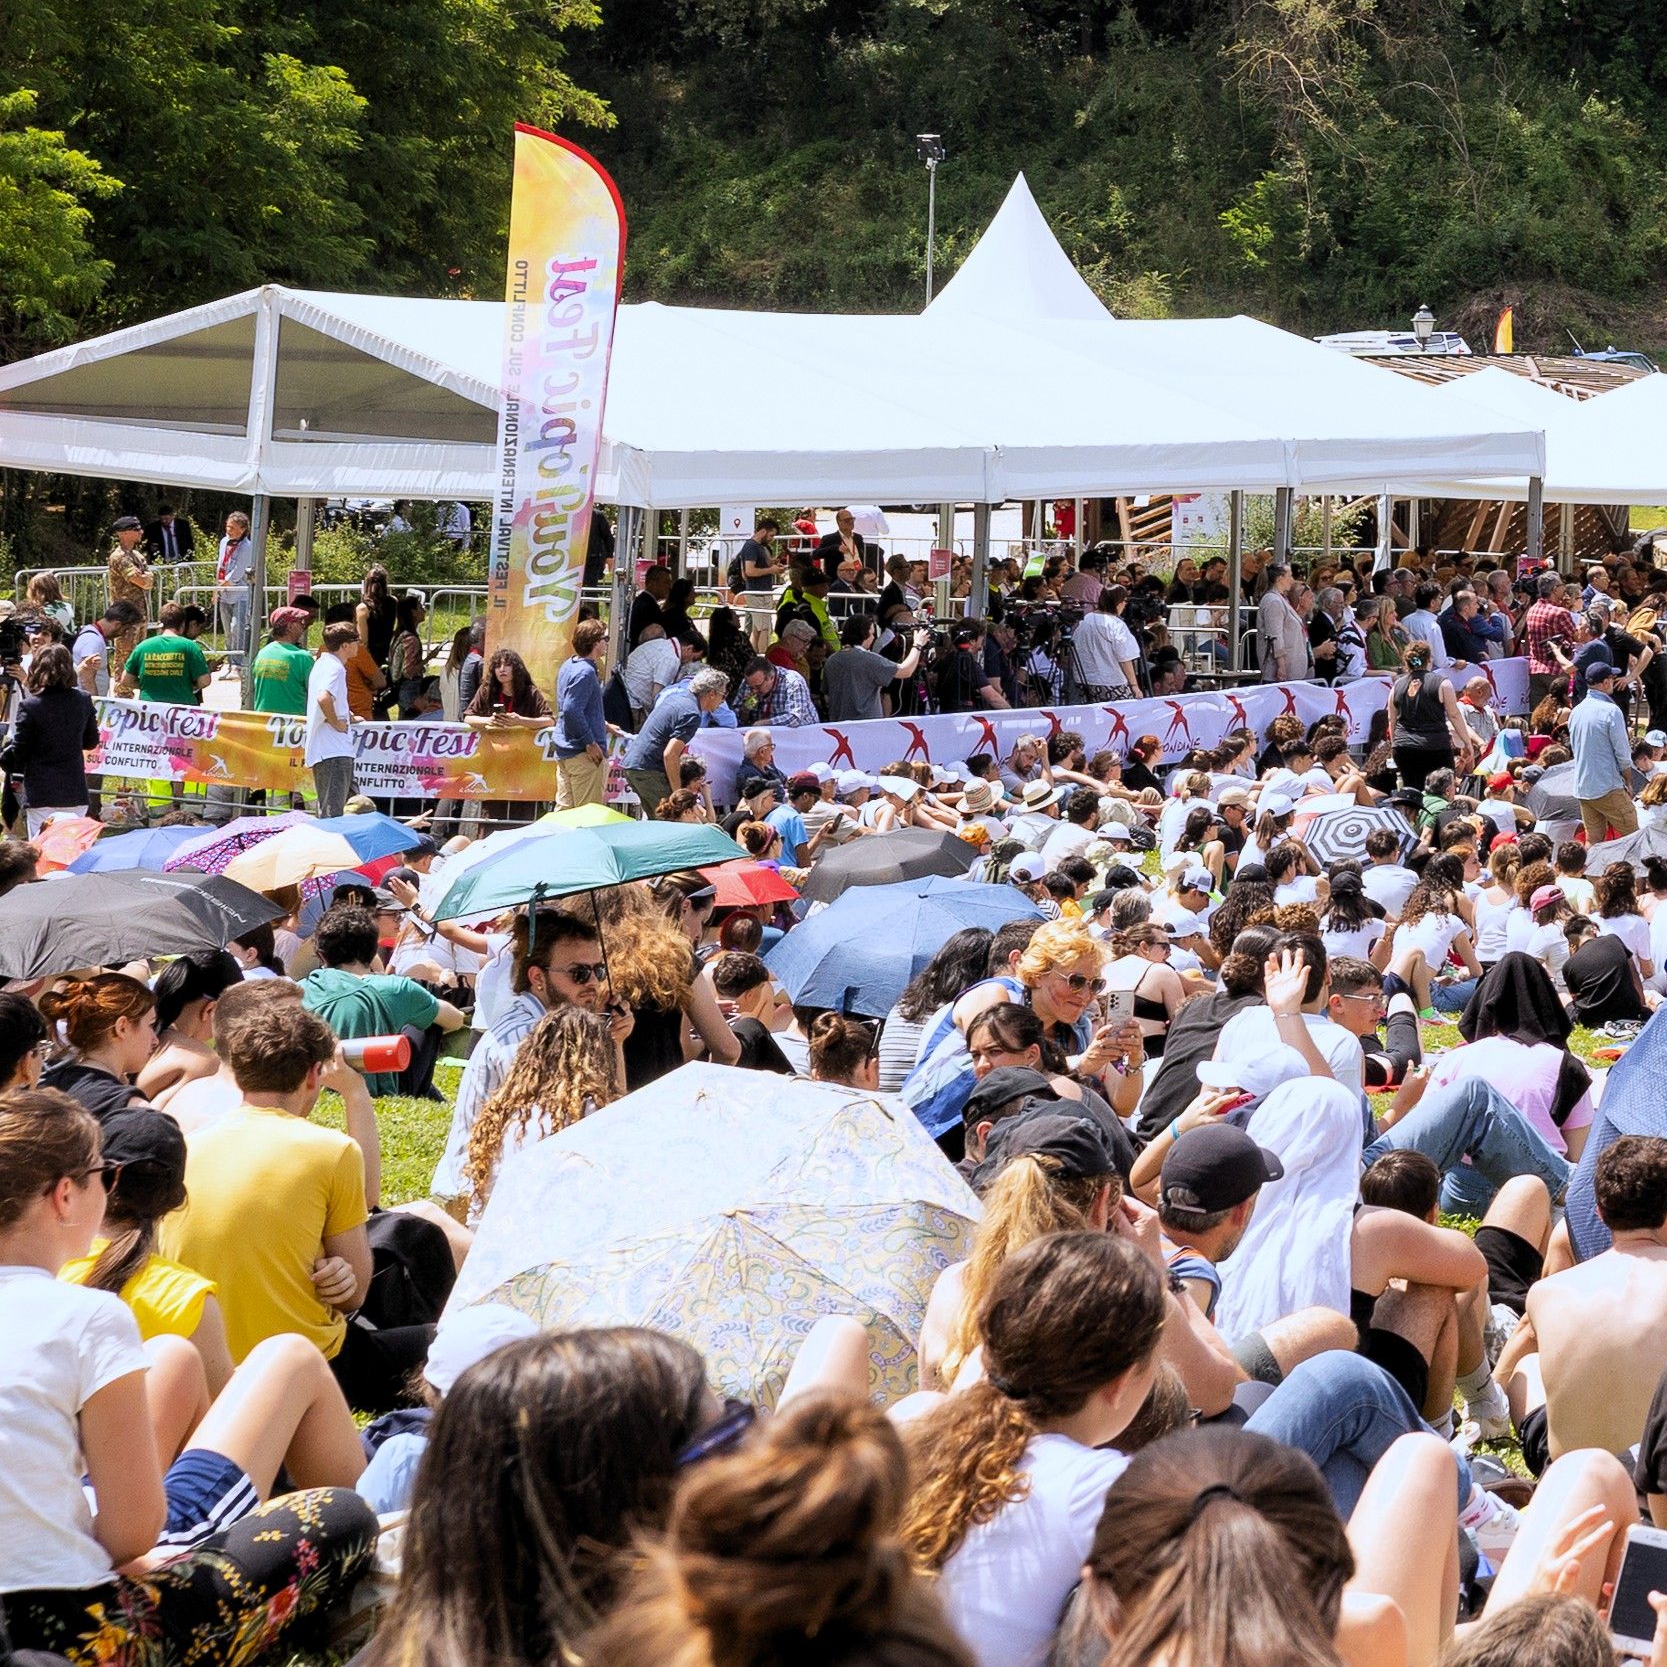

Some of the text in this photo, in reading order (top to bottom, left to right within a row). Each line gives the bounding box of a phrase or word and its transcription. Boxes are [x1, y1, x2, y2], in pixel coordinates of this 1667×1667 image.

[95, 699, 219, 739] Topic Fest
[415, 726, 479, 756] Fest
[1162, 737, 1201, 753] ONDINE
[112, 741, 194, 758] INTERNAZIONALE
[104, 755, 157, 769] CONFLITTO
[354, 763, 445, 776] NTERNAZIONALE
